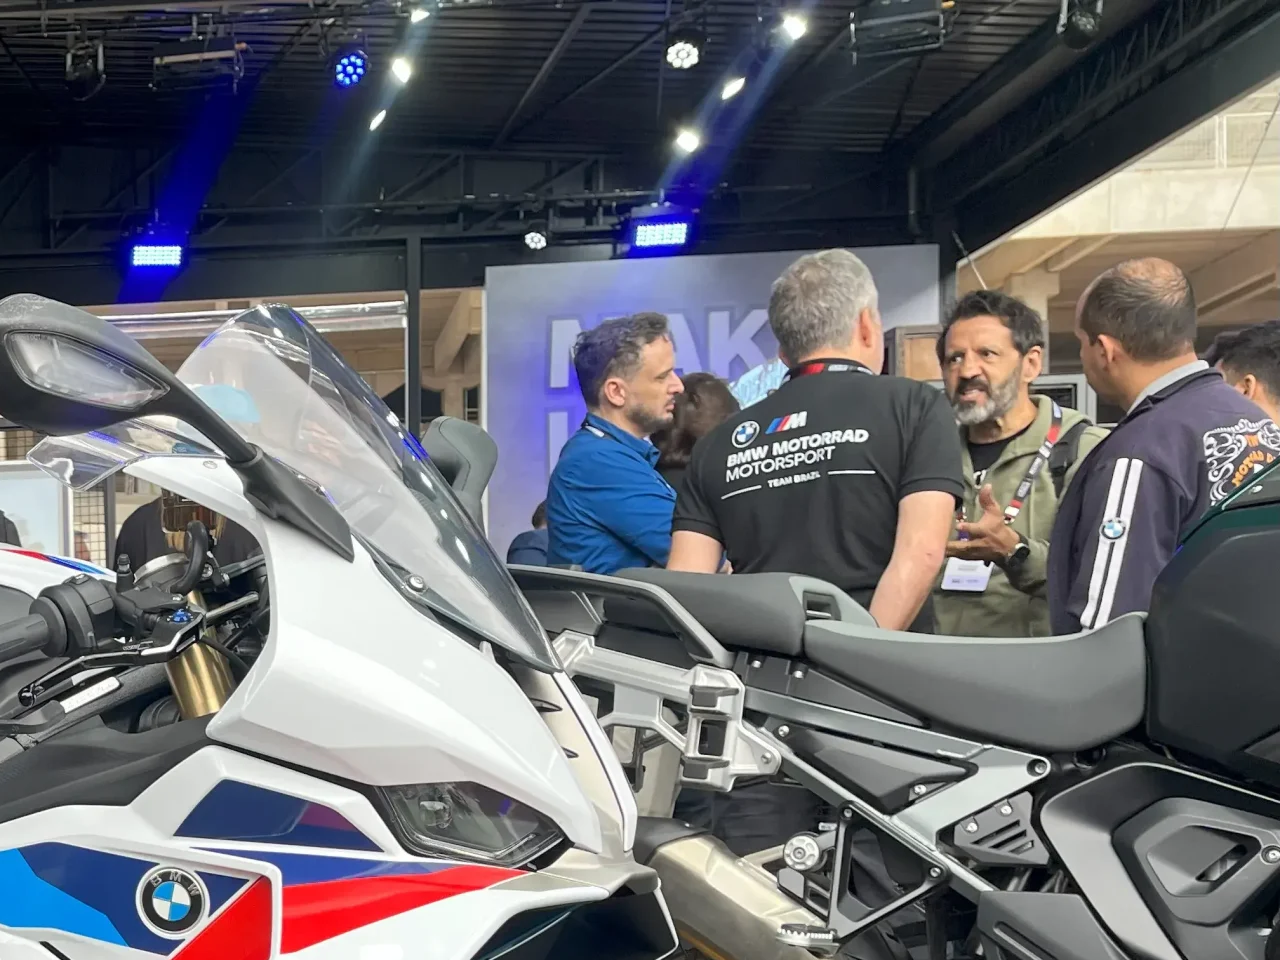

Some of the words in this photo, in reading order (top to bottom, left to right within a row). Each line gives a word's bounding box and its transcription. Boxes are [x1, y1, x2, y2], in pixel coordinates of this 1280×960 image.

[549, 308, 770, 389] AK
[726, 446, 836, 483] MOTORSPORT
[727, 446, 768, 467] BMW
[772, 429, 869, 456] MOTORRAD
[768, 476, 793, 488] TEAM
[150, 869, 200, 897] BMW
